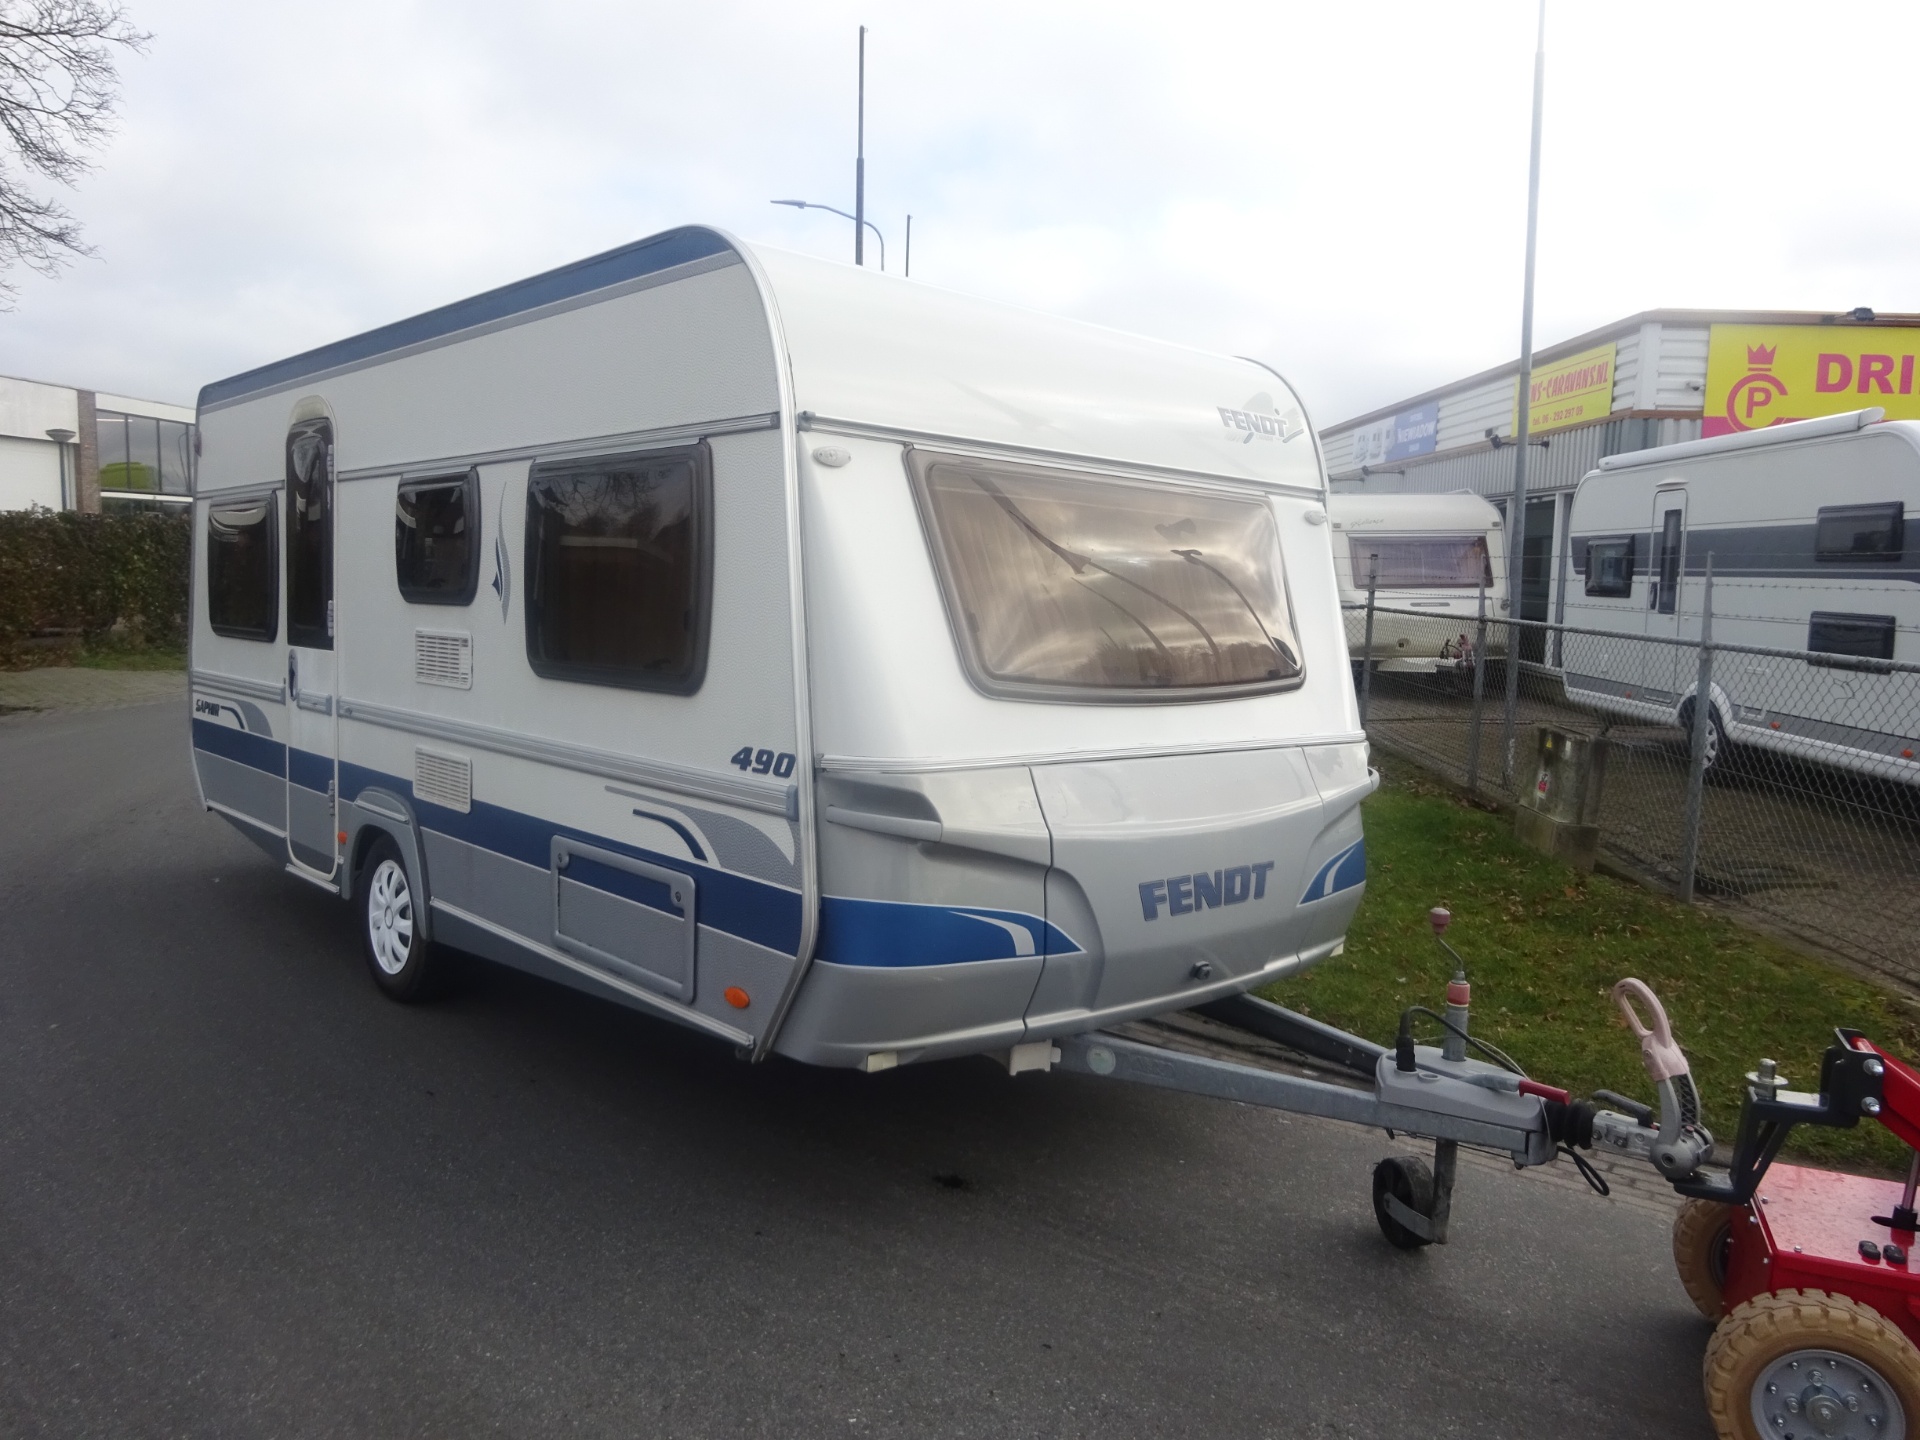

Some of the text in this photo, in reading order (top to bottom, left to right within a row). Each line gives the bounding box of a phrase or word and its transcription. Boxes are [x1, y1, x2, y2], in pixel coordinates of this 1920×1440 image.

[1815, 353, 1920, 395] DRI
[1216, 406, 1287, 437] FENDT
[195, 699, 220, 717] SAPHIR
[730, 746, 796, 779] 490
[1139, 860, 1275, 922] FENDT
